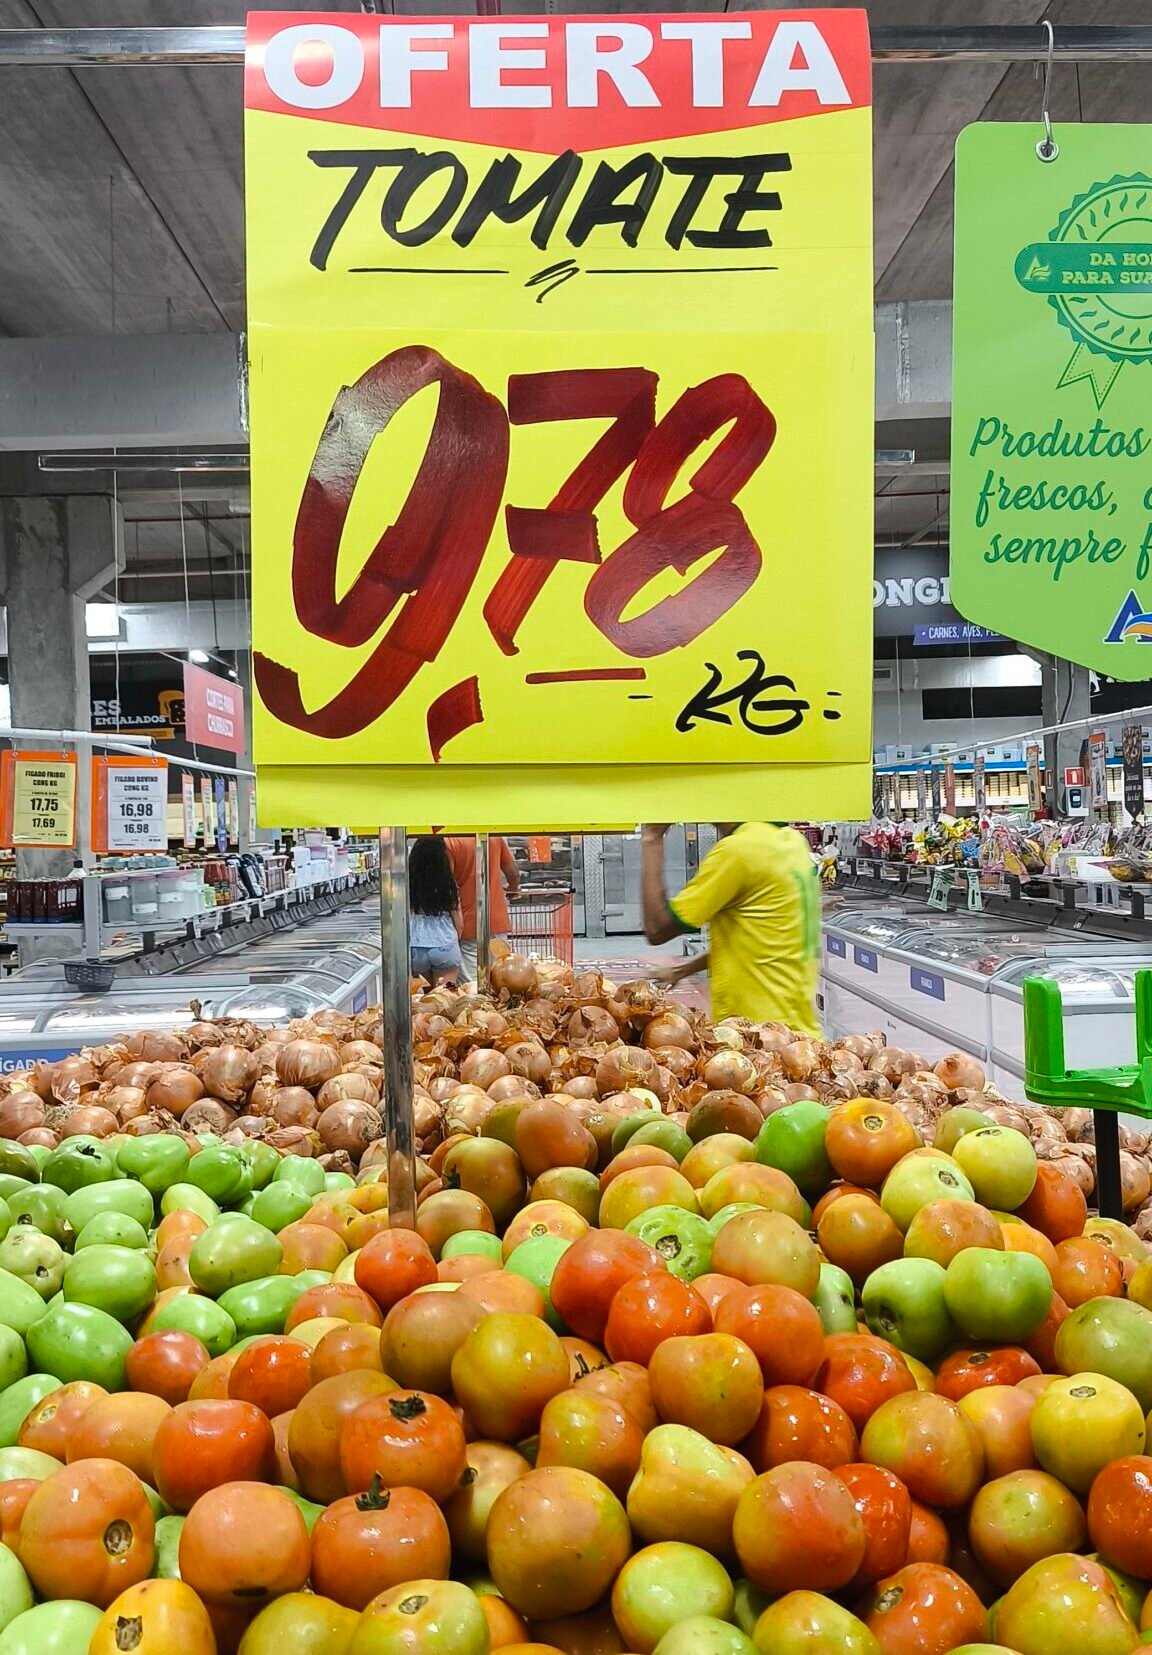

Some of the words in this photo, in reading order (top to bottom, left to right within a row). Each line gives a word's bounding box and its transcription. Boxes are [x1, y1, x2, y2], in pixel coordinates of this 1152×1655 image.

[262, 21, 853, 109] OFERTA
[307, 148, 793, 272] TOMATE
[1089, 253, 1117, 266] DA
[1123, 253, 1152, 266] HO
[1062, 271, 1115, 285] PARA
[969, 416, 1151, 458] Produtos
[975, 470, 1118, 528] frescos,
[253, 344, 778, 763] 9,78
[983, 529, 1127, 582] sempre
[928, 626, 960, 639] CARNES,
[962, 625, 983, 638] AVES,
[92, 699, 121, 716] ES
[94, 715, 166, 726] EMBALADOS
[30, 797, 59, 812] 17,75
[119, 803, 153, 817] 16,98
[32, 818, 56, 829] 17,69
[123, 823, 149, 834] 16,98
